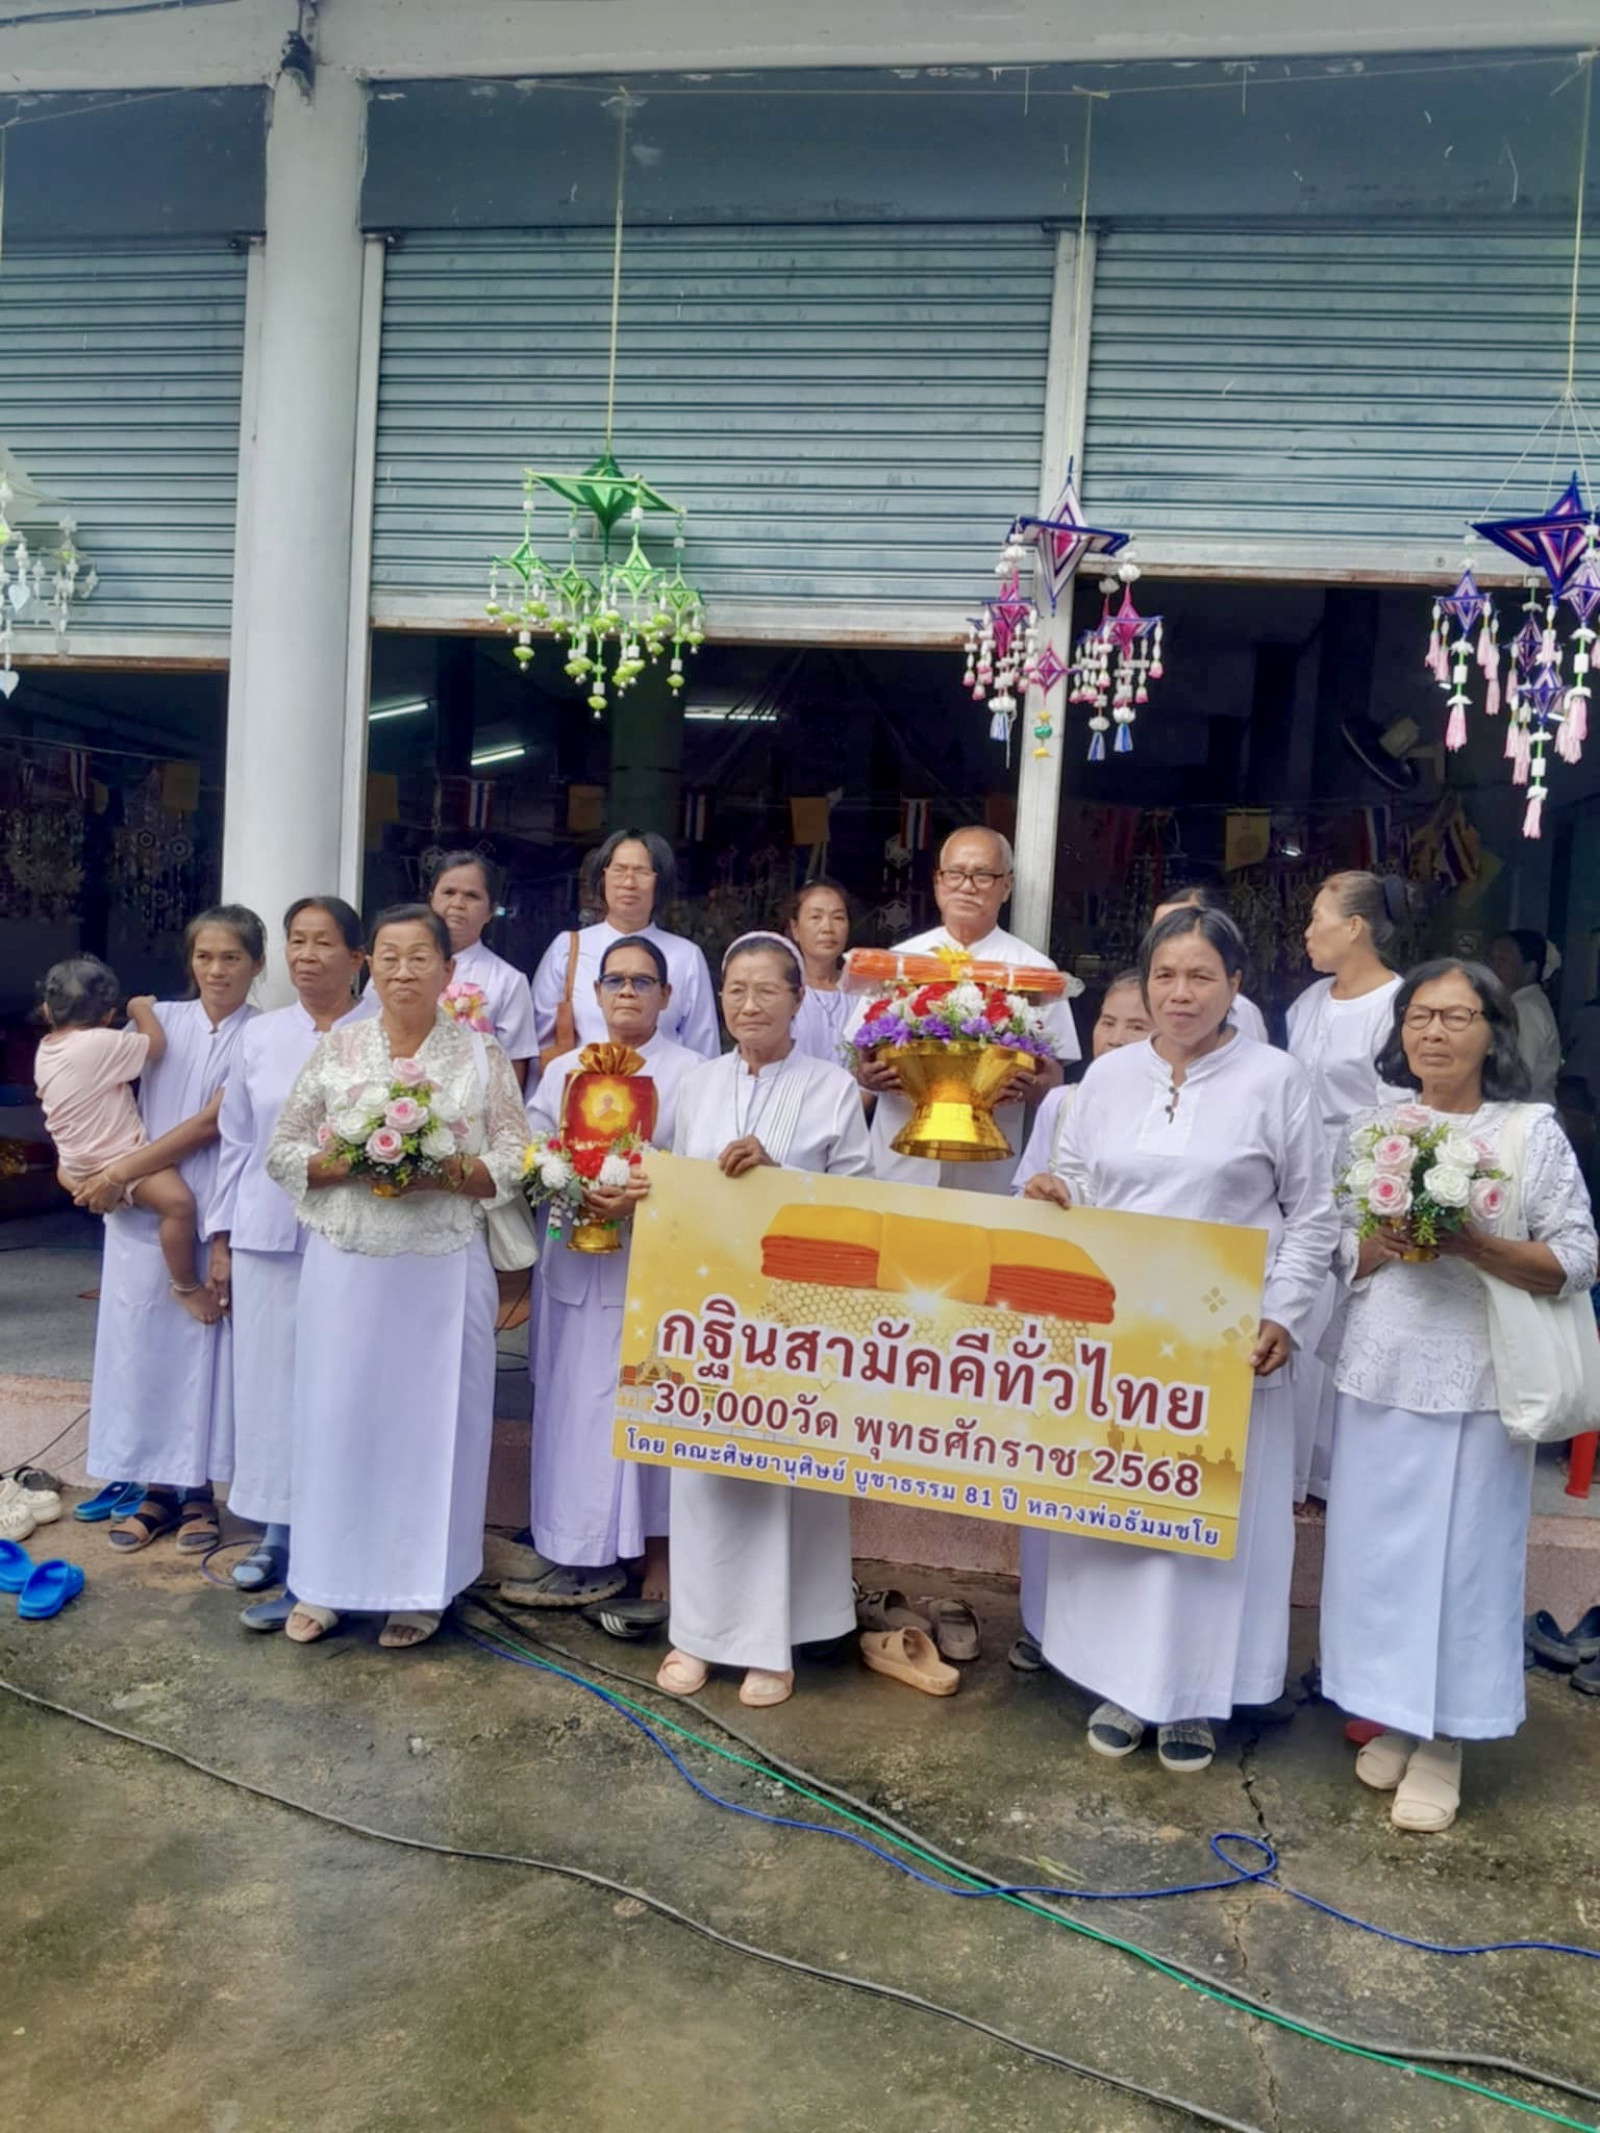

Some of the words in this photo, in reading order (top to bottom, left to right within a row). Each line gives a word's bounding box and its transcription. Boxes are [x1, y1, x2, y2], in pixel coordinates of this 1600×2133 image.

[661, 1298, 1204, 1431] กฐินสามัคคีทั่วไทย
[627, 1427, 665, 1454] โดย
[674, 1442, 846, 1483] คณะศิษยานุศิษย์
[855, 1470, 956, 1500] บูชาธรรม
[965, 1486, 991, 1507] 81
[1002, 1487, 1019, 1511] ปี
[654, 1383, 838, 1439] 30,000วัด
[854, 1416, 1077, 1477] พุทธศักราช
[1091, 1450, 1200, 1497] 2568
